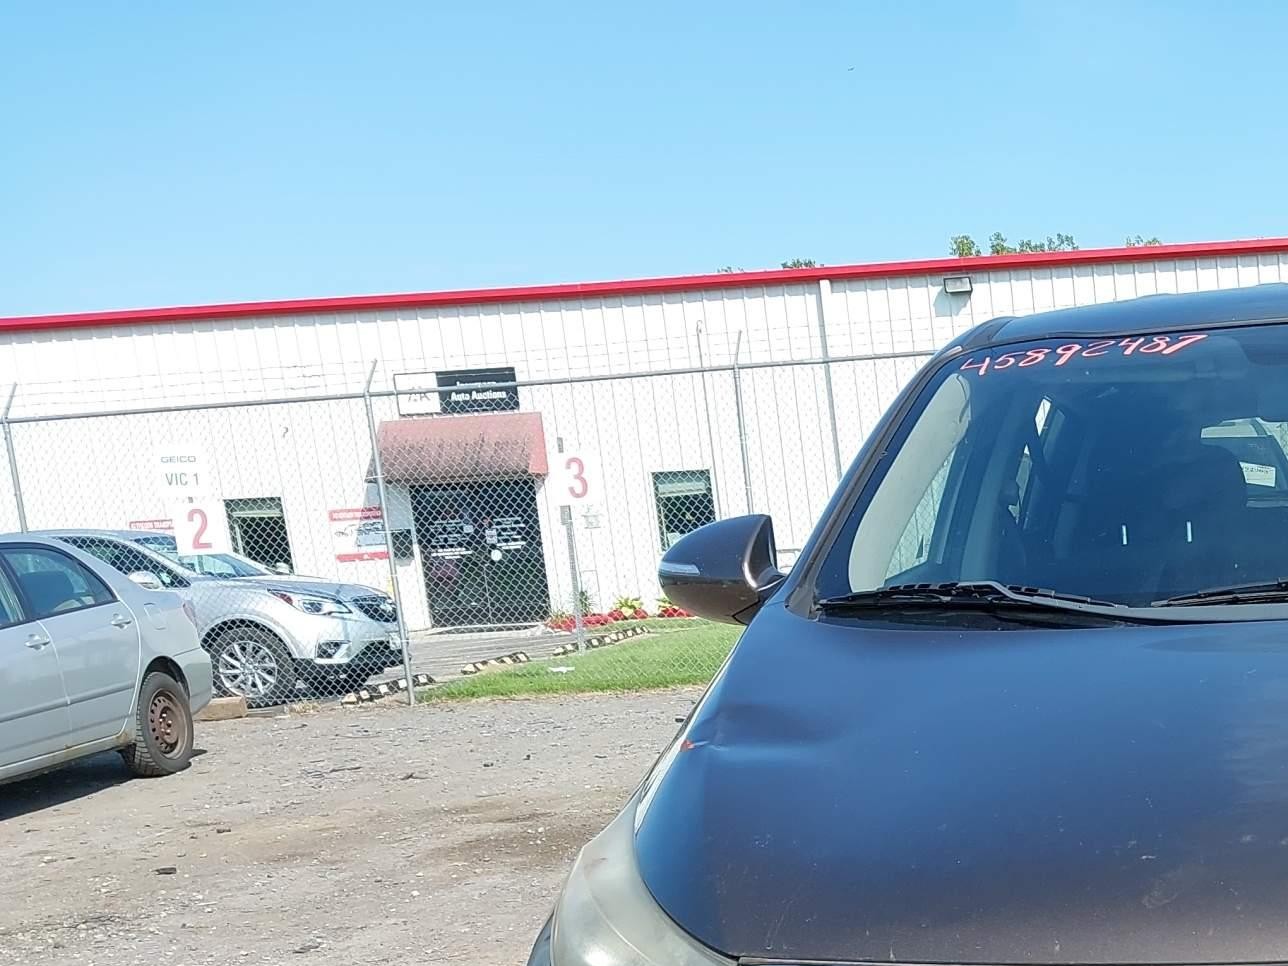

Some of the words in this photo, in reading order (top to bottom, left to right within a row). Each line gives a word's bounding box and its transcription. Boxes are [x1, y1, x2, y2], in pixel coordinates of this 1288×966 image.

[959, 334, 1208, 376] 45892487
[160, 455, 197, 463] GEICO
[165, 472, 188, 486] VIC
[193, 472, 199, 486] 1
[565, 457, 588, 499] 3
[187, 508, 213, 549] 2
